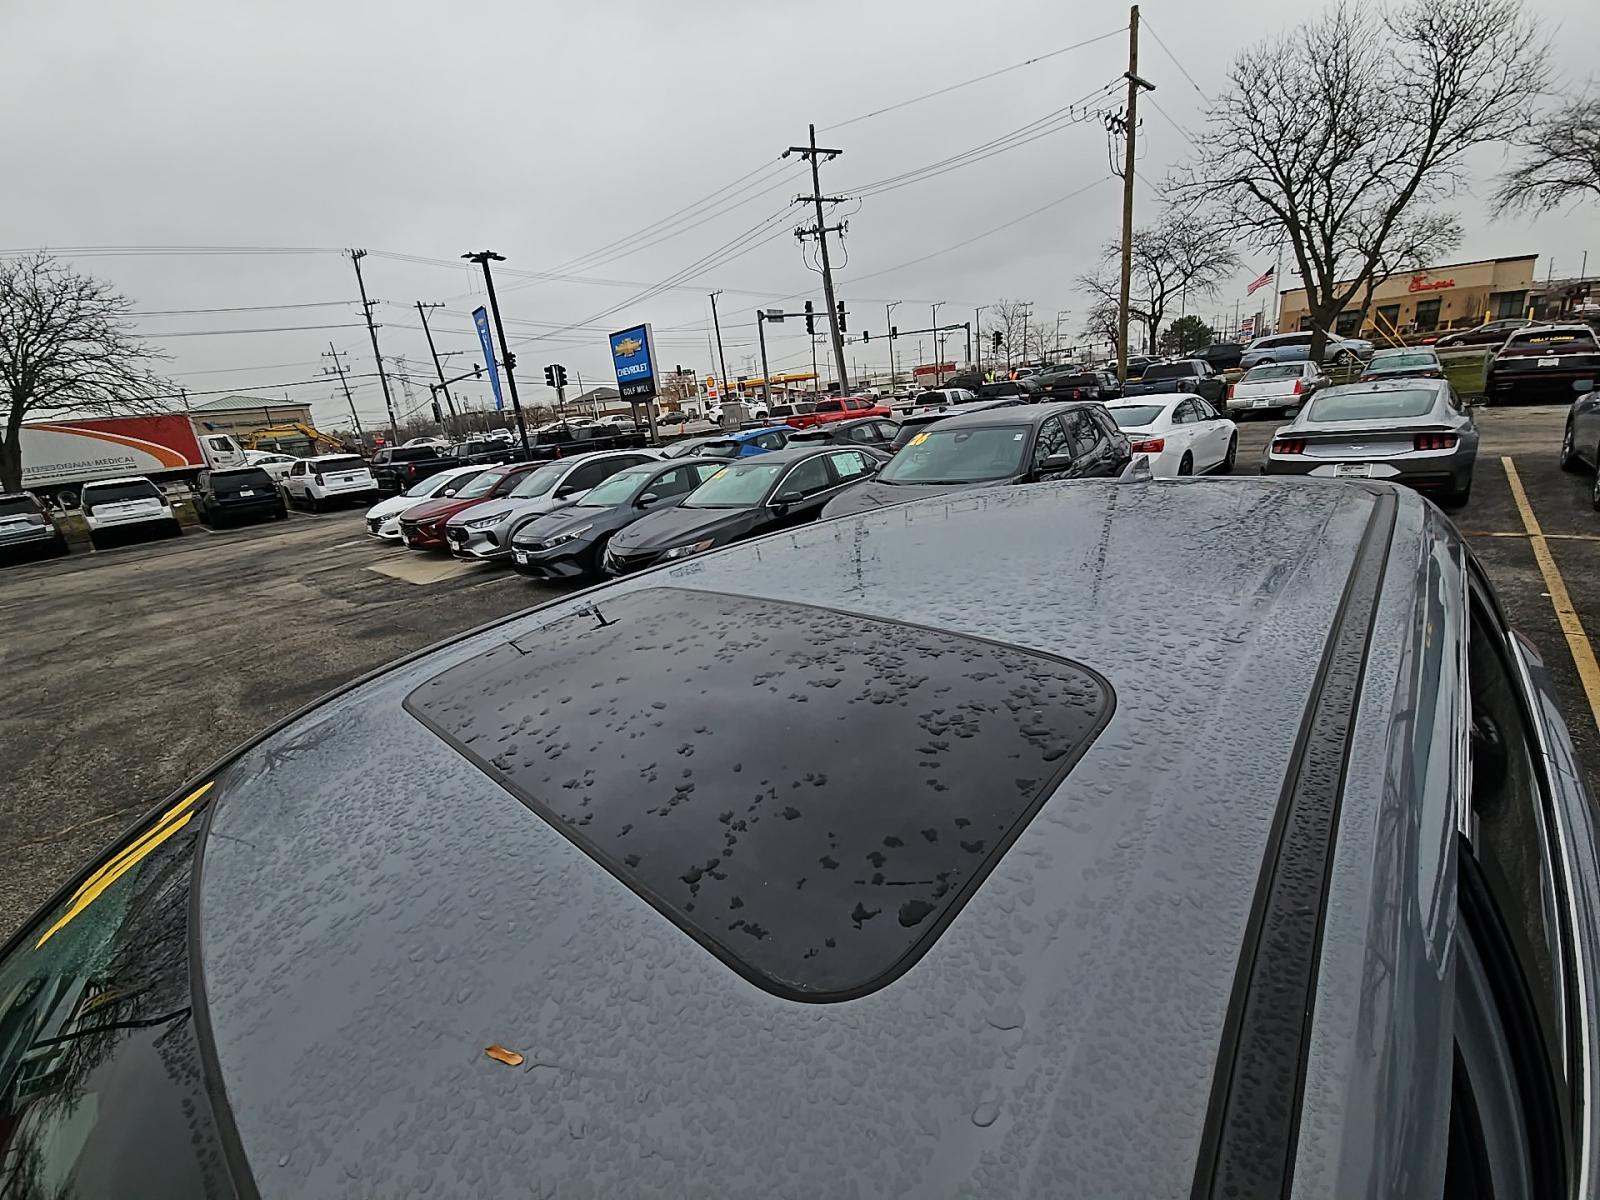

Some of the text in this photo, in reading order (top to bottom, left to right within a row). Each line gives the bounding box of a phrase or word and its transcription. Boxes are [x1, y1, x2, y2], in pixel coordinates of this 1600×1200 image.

[617, 362, 648, 377] CHEVROLET
[623, 384, 650, 396] GOLF MILL
[94, 456, 136, 466] MEDICAL
